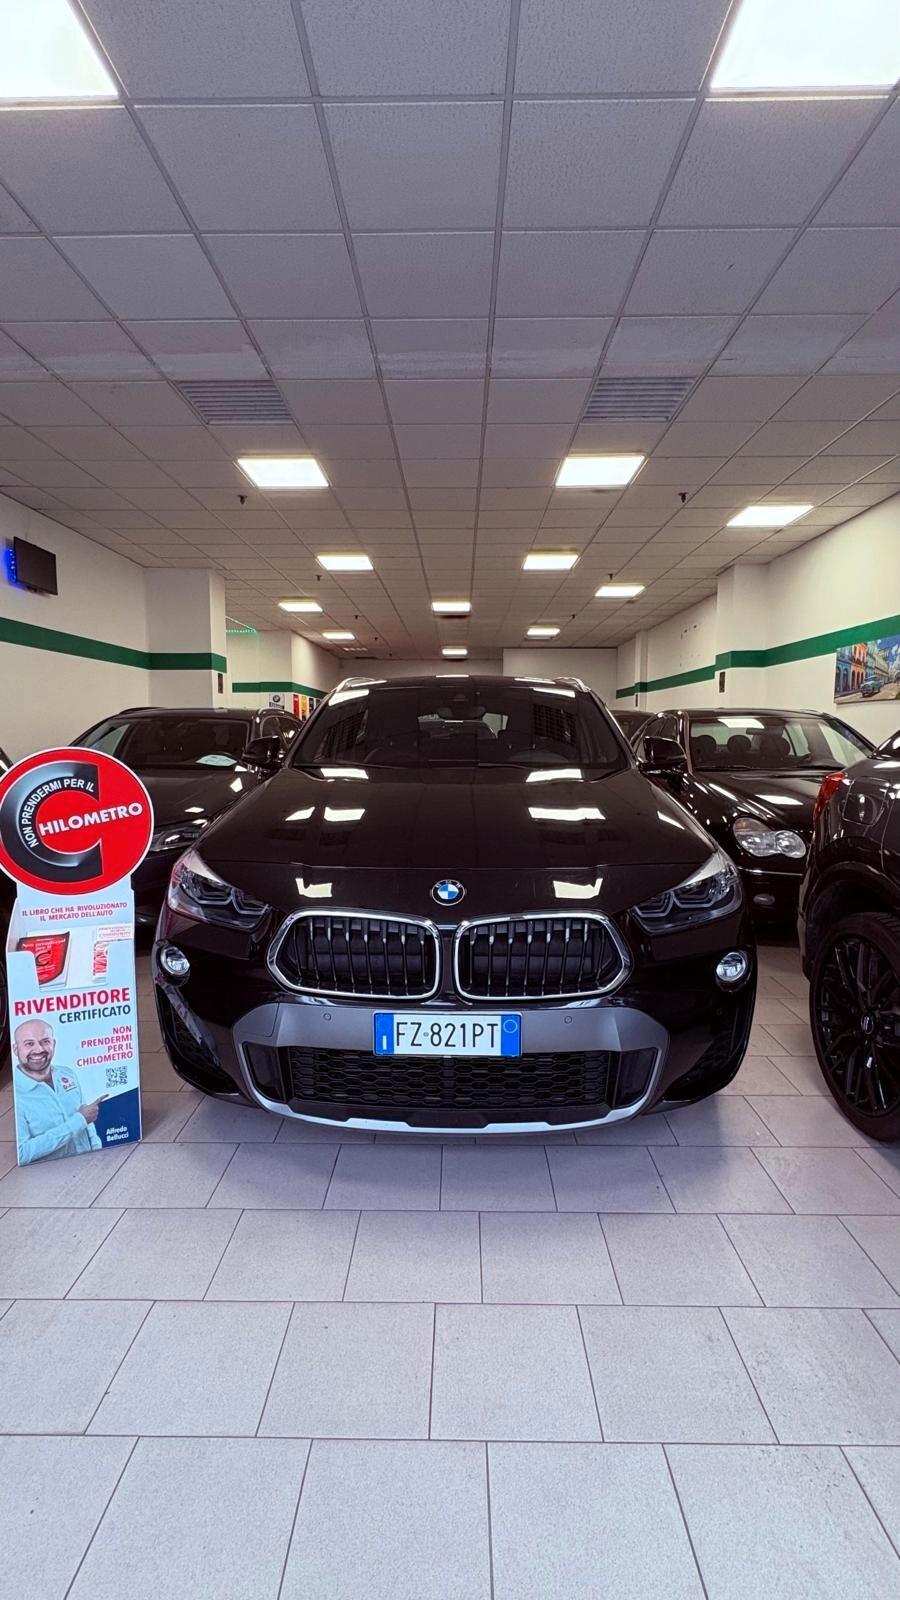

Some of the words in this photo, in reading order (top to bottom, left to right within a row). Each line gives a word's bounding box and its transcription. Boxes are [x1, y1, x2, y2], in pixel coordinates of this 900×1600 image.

[64, 778, 84, 789] PER
[86, 781, 95, 793] IL
[21, 780, 62, 825] PRENDERMI
[22, 827, 39, 848] NON
[29, 908, 49, 916] LIBRO
[77, 902, 128, 911] RIVOLUZIONATO
[48, 913, 80, 921] MERCATO
[14, 987, 130, 1016] RIVENDITORE
[58, 1005, 131, 1024] CERTIFICATO
[112, 1025, 132, 1035] NON
[80, 1034, 133, 1048] PRENDERMI
[107, 1045, 124, 1053] PER
[76, 1052, 133, 1067] CHILOMETRO
[106, 1126, 128, 1135] Alfredo
[106, 1133, 129, 1142] Bellucci
